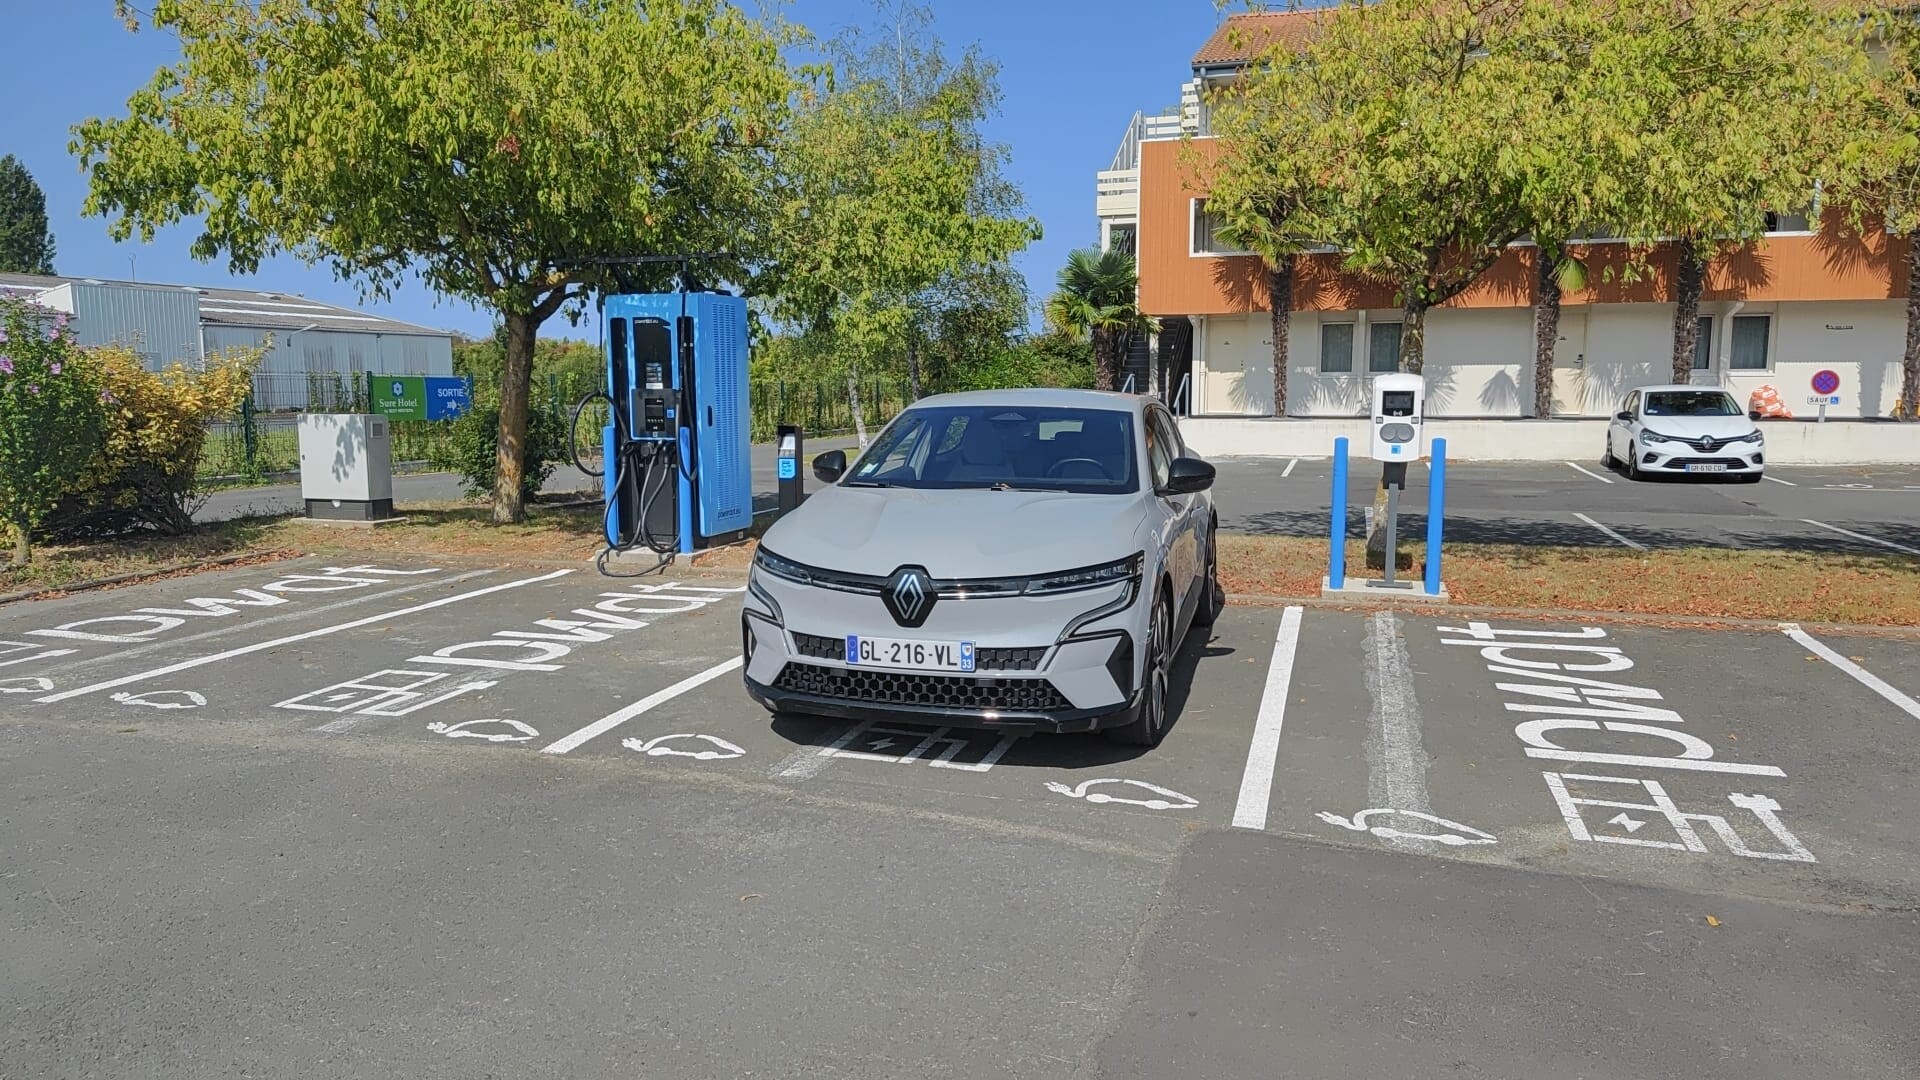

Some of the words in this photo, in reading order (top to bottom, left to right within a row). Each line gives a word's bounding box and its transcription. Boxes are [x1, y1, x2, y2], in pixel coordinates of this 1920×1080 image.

[437, 388, 465, 397] SORTIE
[379, 398, 397, 408] Sure
[398, 397, 418, 408] Hotel
[859, 640, 958, 666] GL-216-VL
[961, 658, 972, 669] 33
